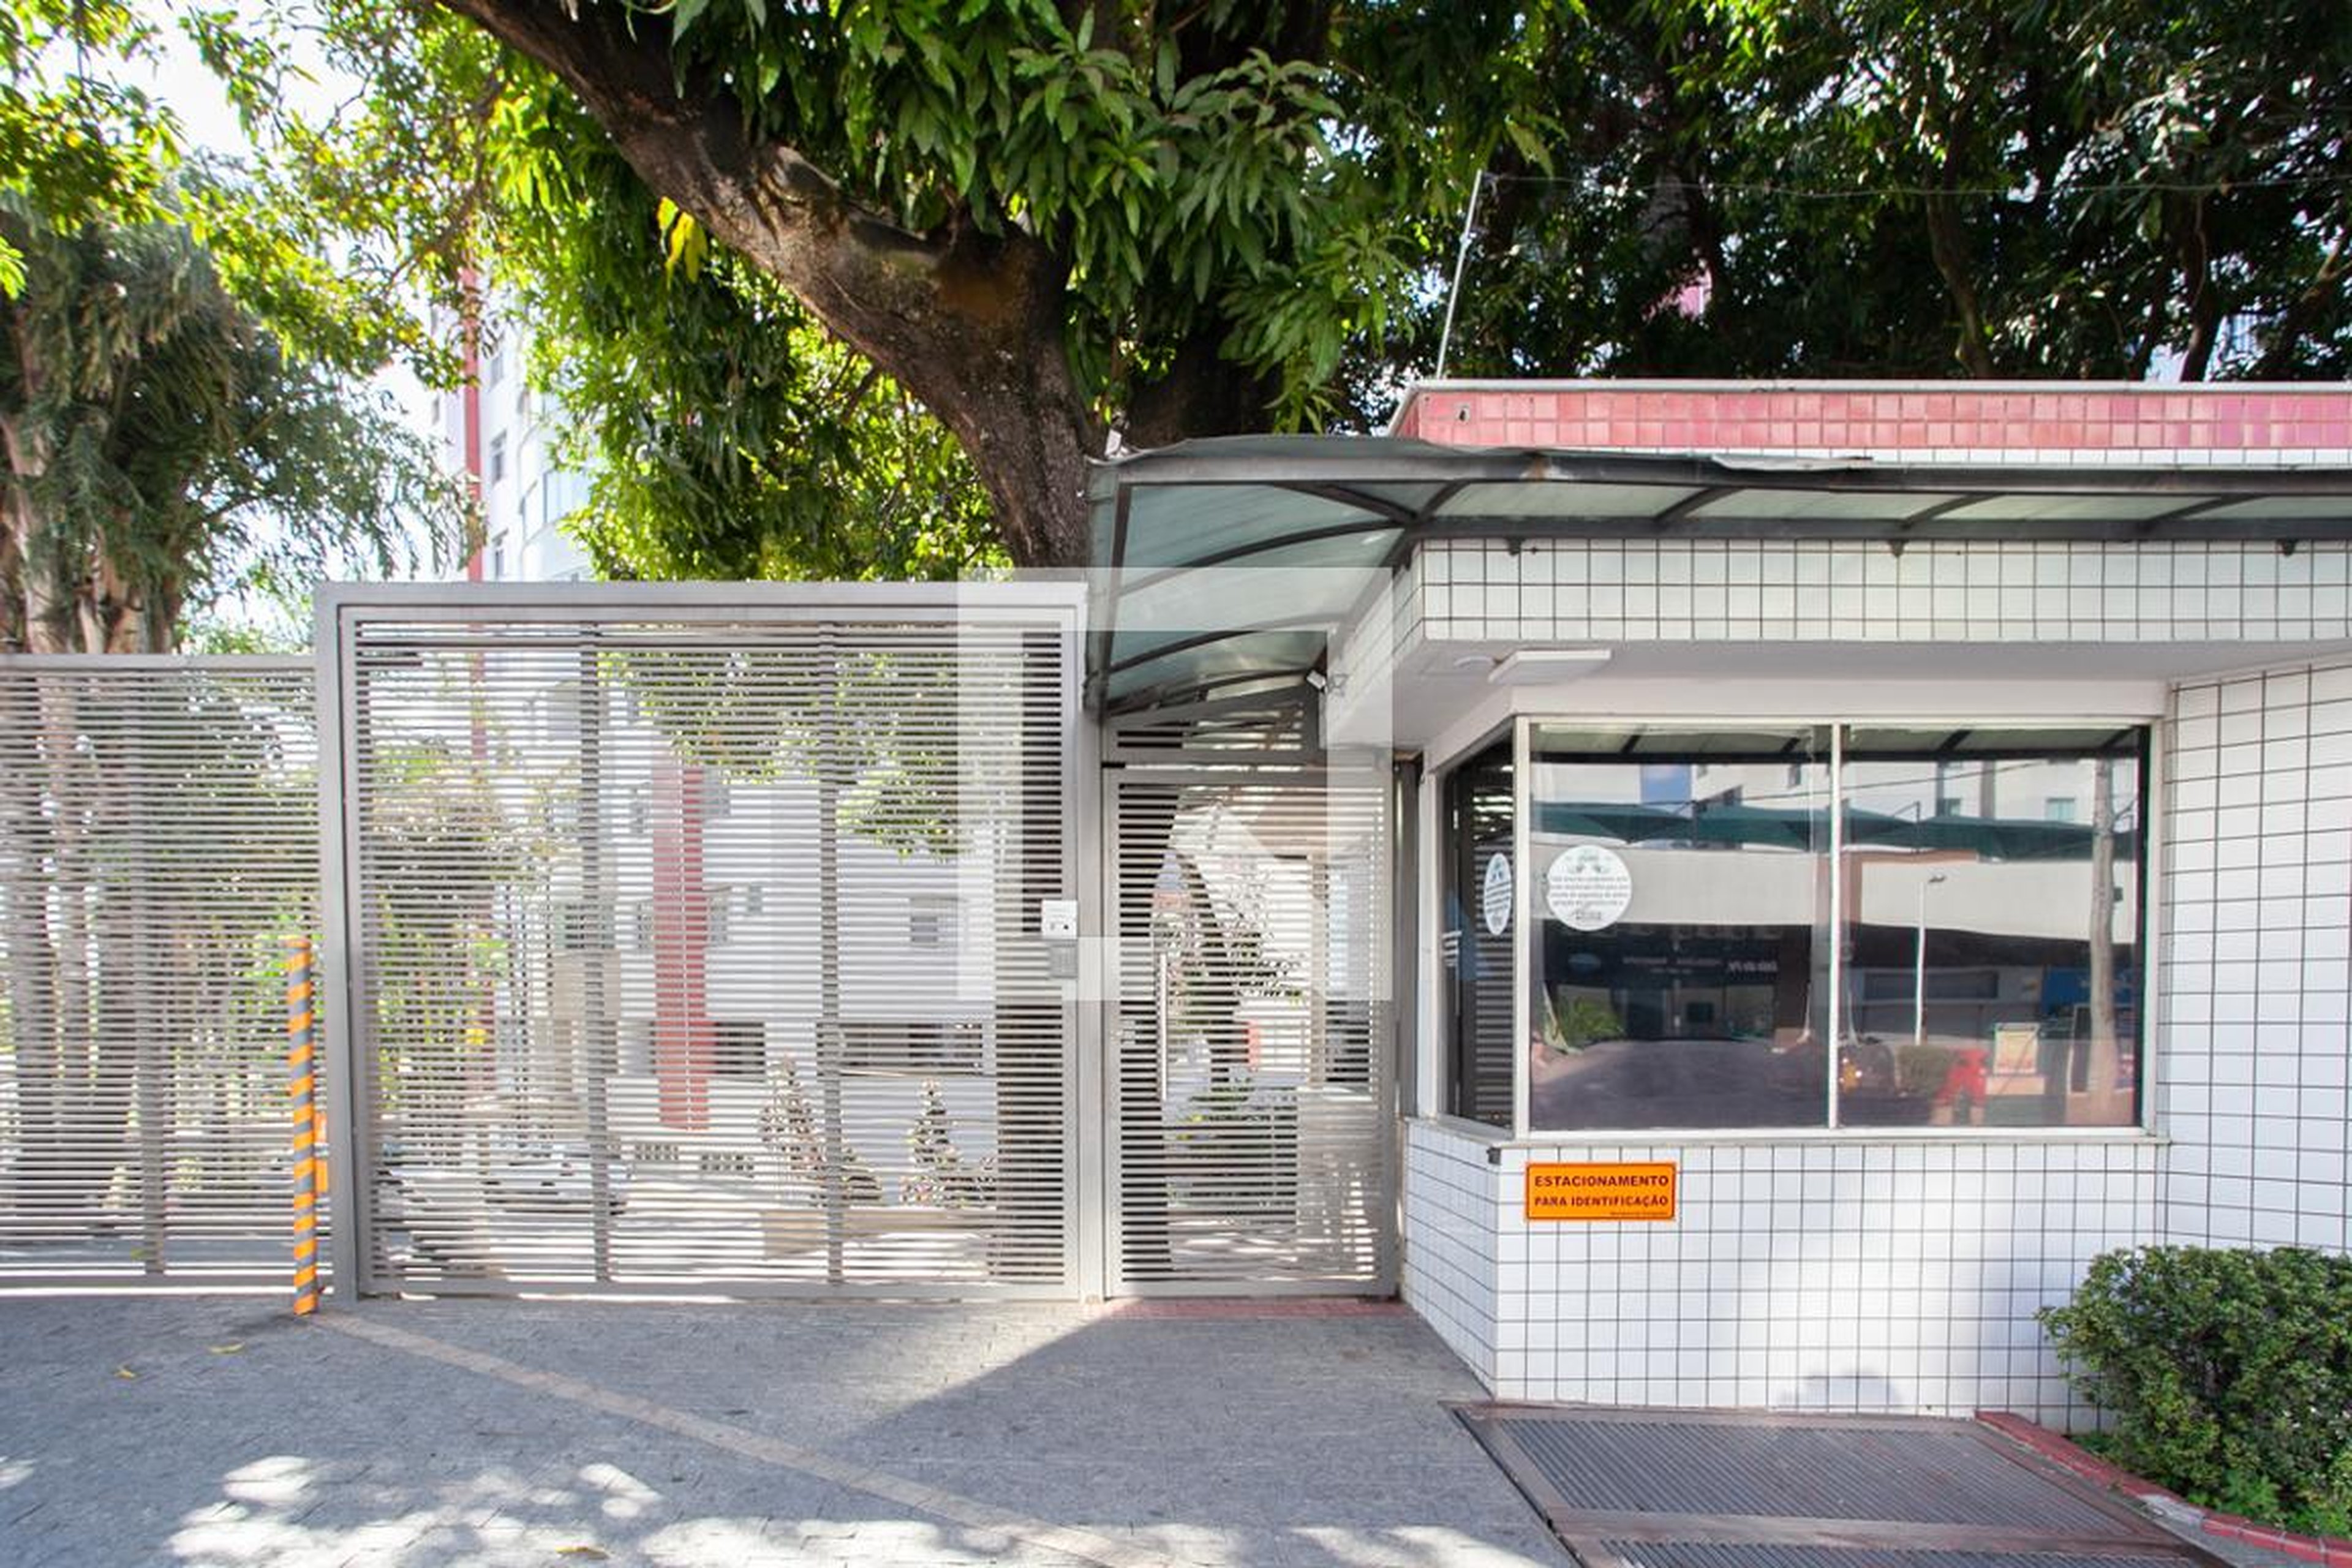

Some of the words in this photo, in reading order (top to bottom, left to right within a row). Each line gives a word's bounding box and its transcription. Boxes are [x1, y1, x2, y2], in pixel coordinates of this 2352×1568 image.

[1535, 1175, 1668, 1186] ESTACIONAMENTO
[1535, 1196, 1567, 1206] PARA
[1571, 1195, 1668, 1207] IDENTIFICAÇÃO
